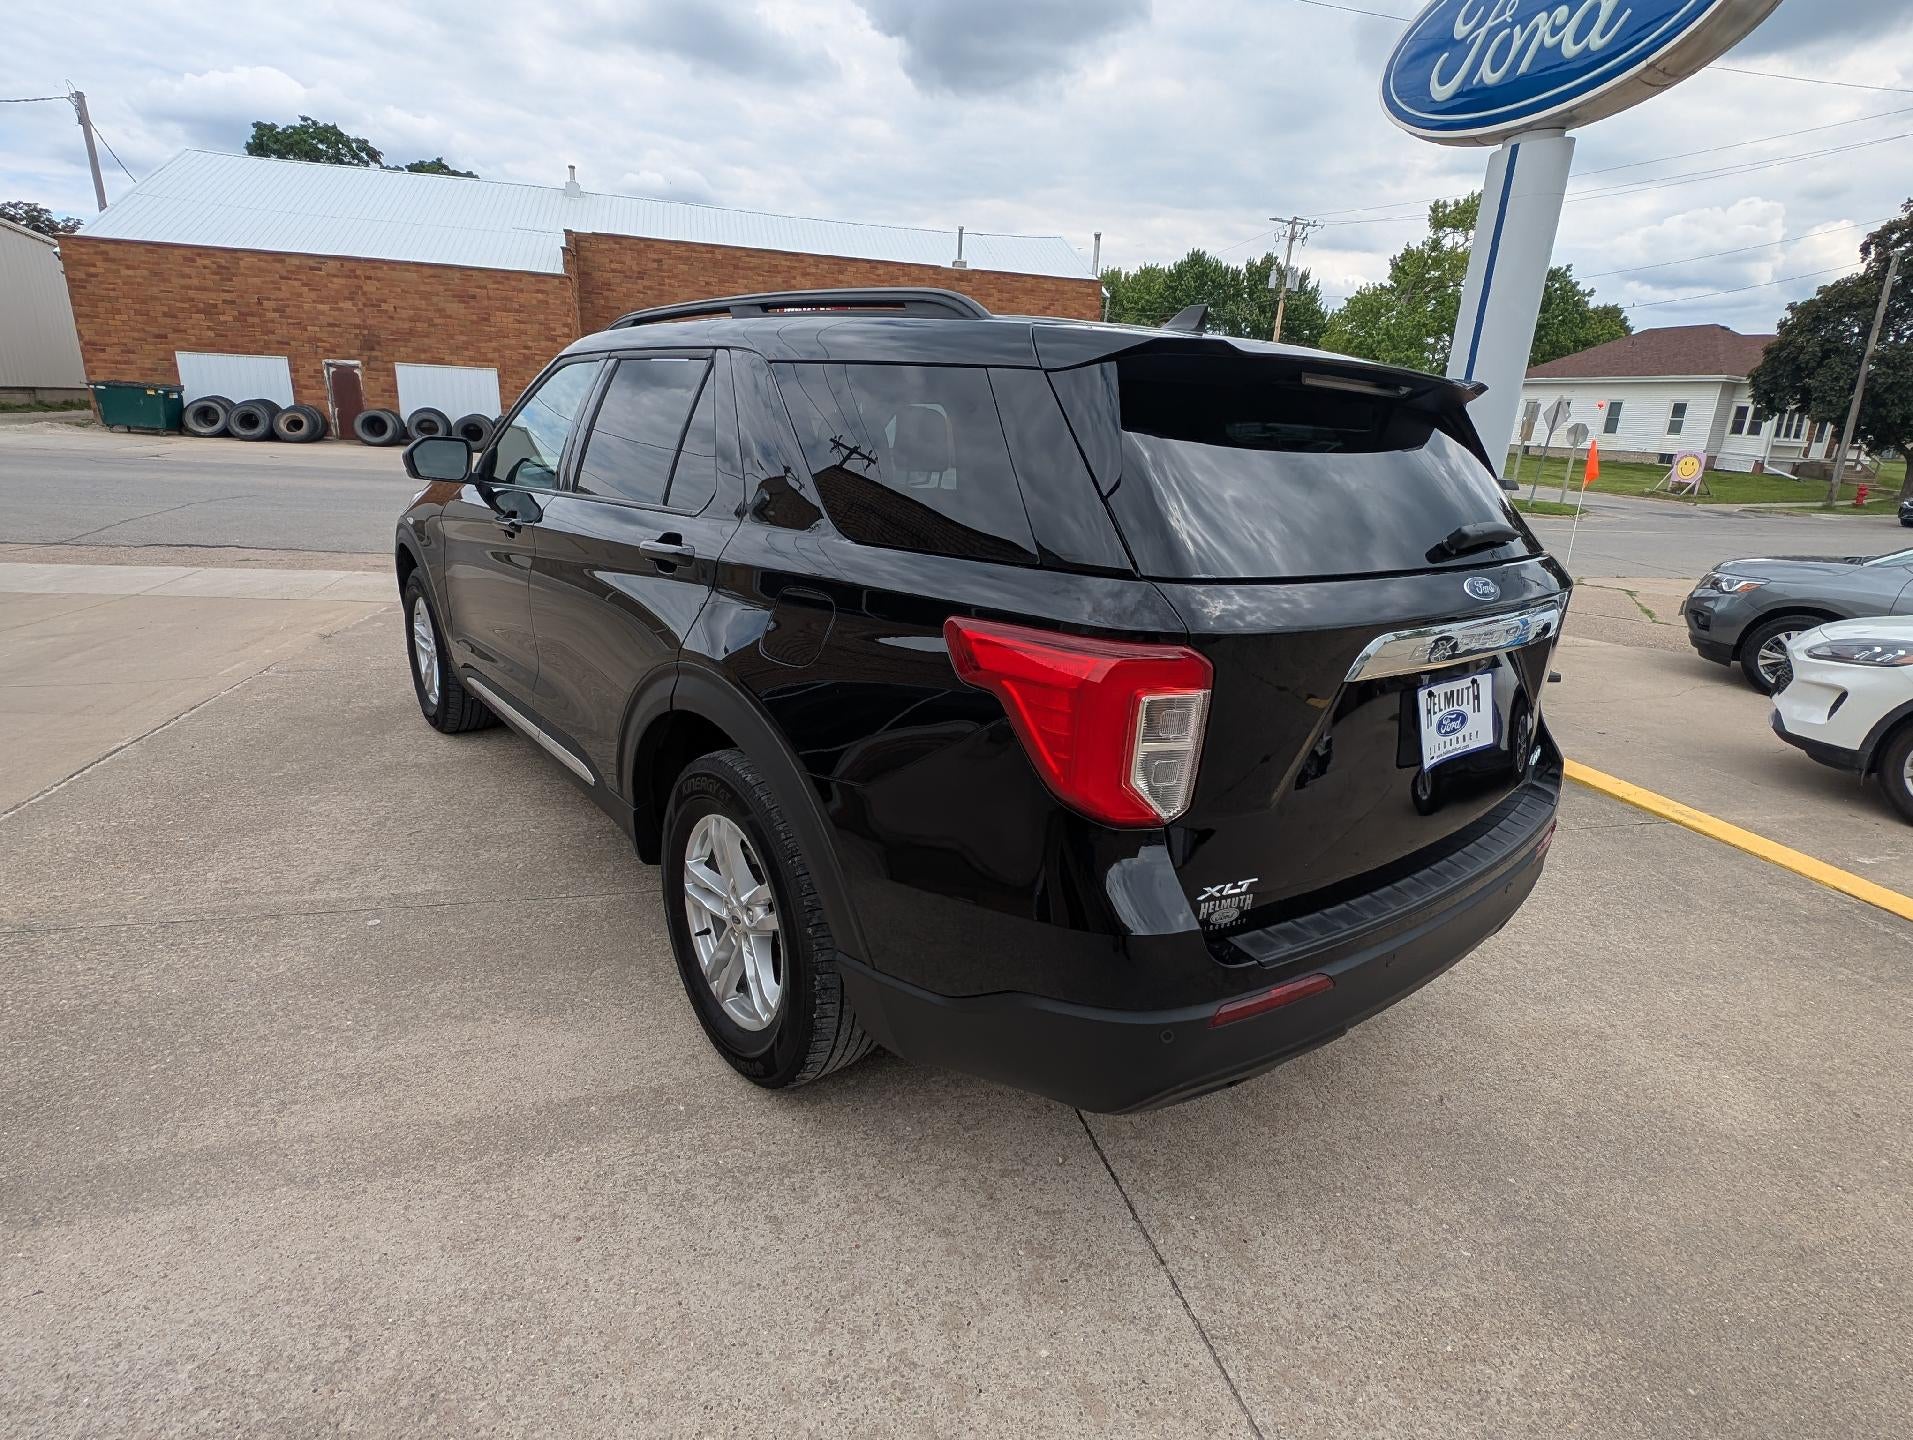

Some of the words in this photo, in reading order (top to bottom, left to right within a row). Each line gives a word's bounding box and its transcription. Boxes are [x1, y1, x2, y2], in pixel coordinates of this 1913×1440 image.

[1430, 0, 1632, 102] Ford
[1426, 682, 1481, 729] HELMUTH
[1440, 713, 1463, 733] Ford
[1196, 877, 1259, 901] XLT
[1199, 893, 1254, 920] HELMUTH
